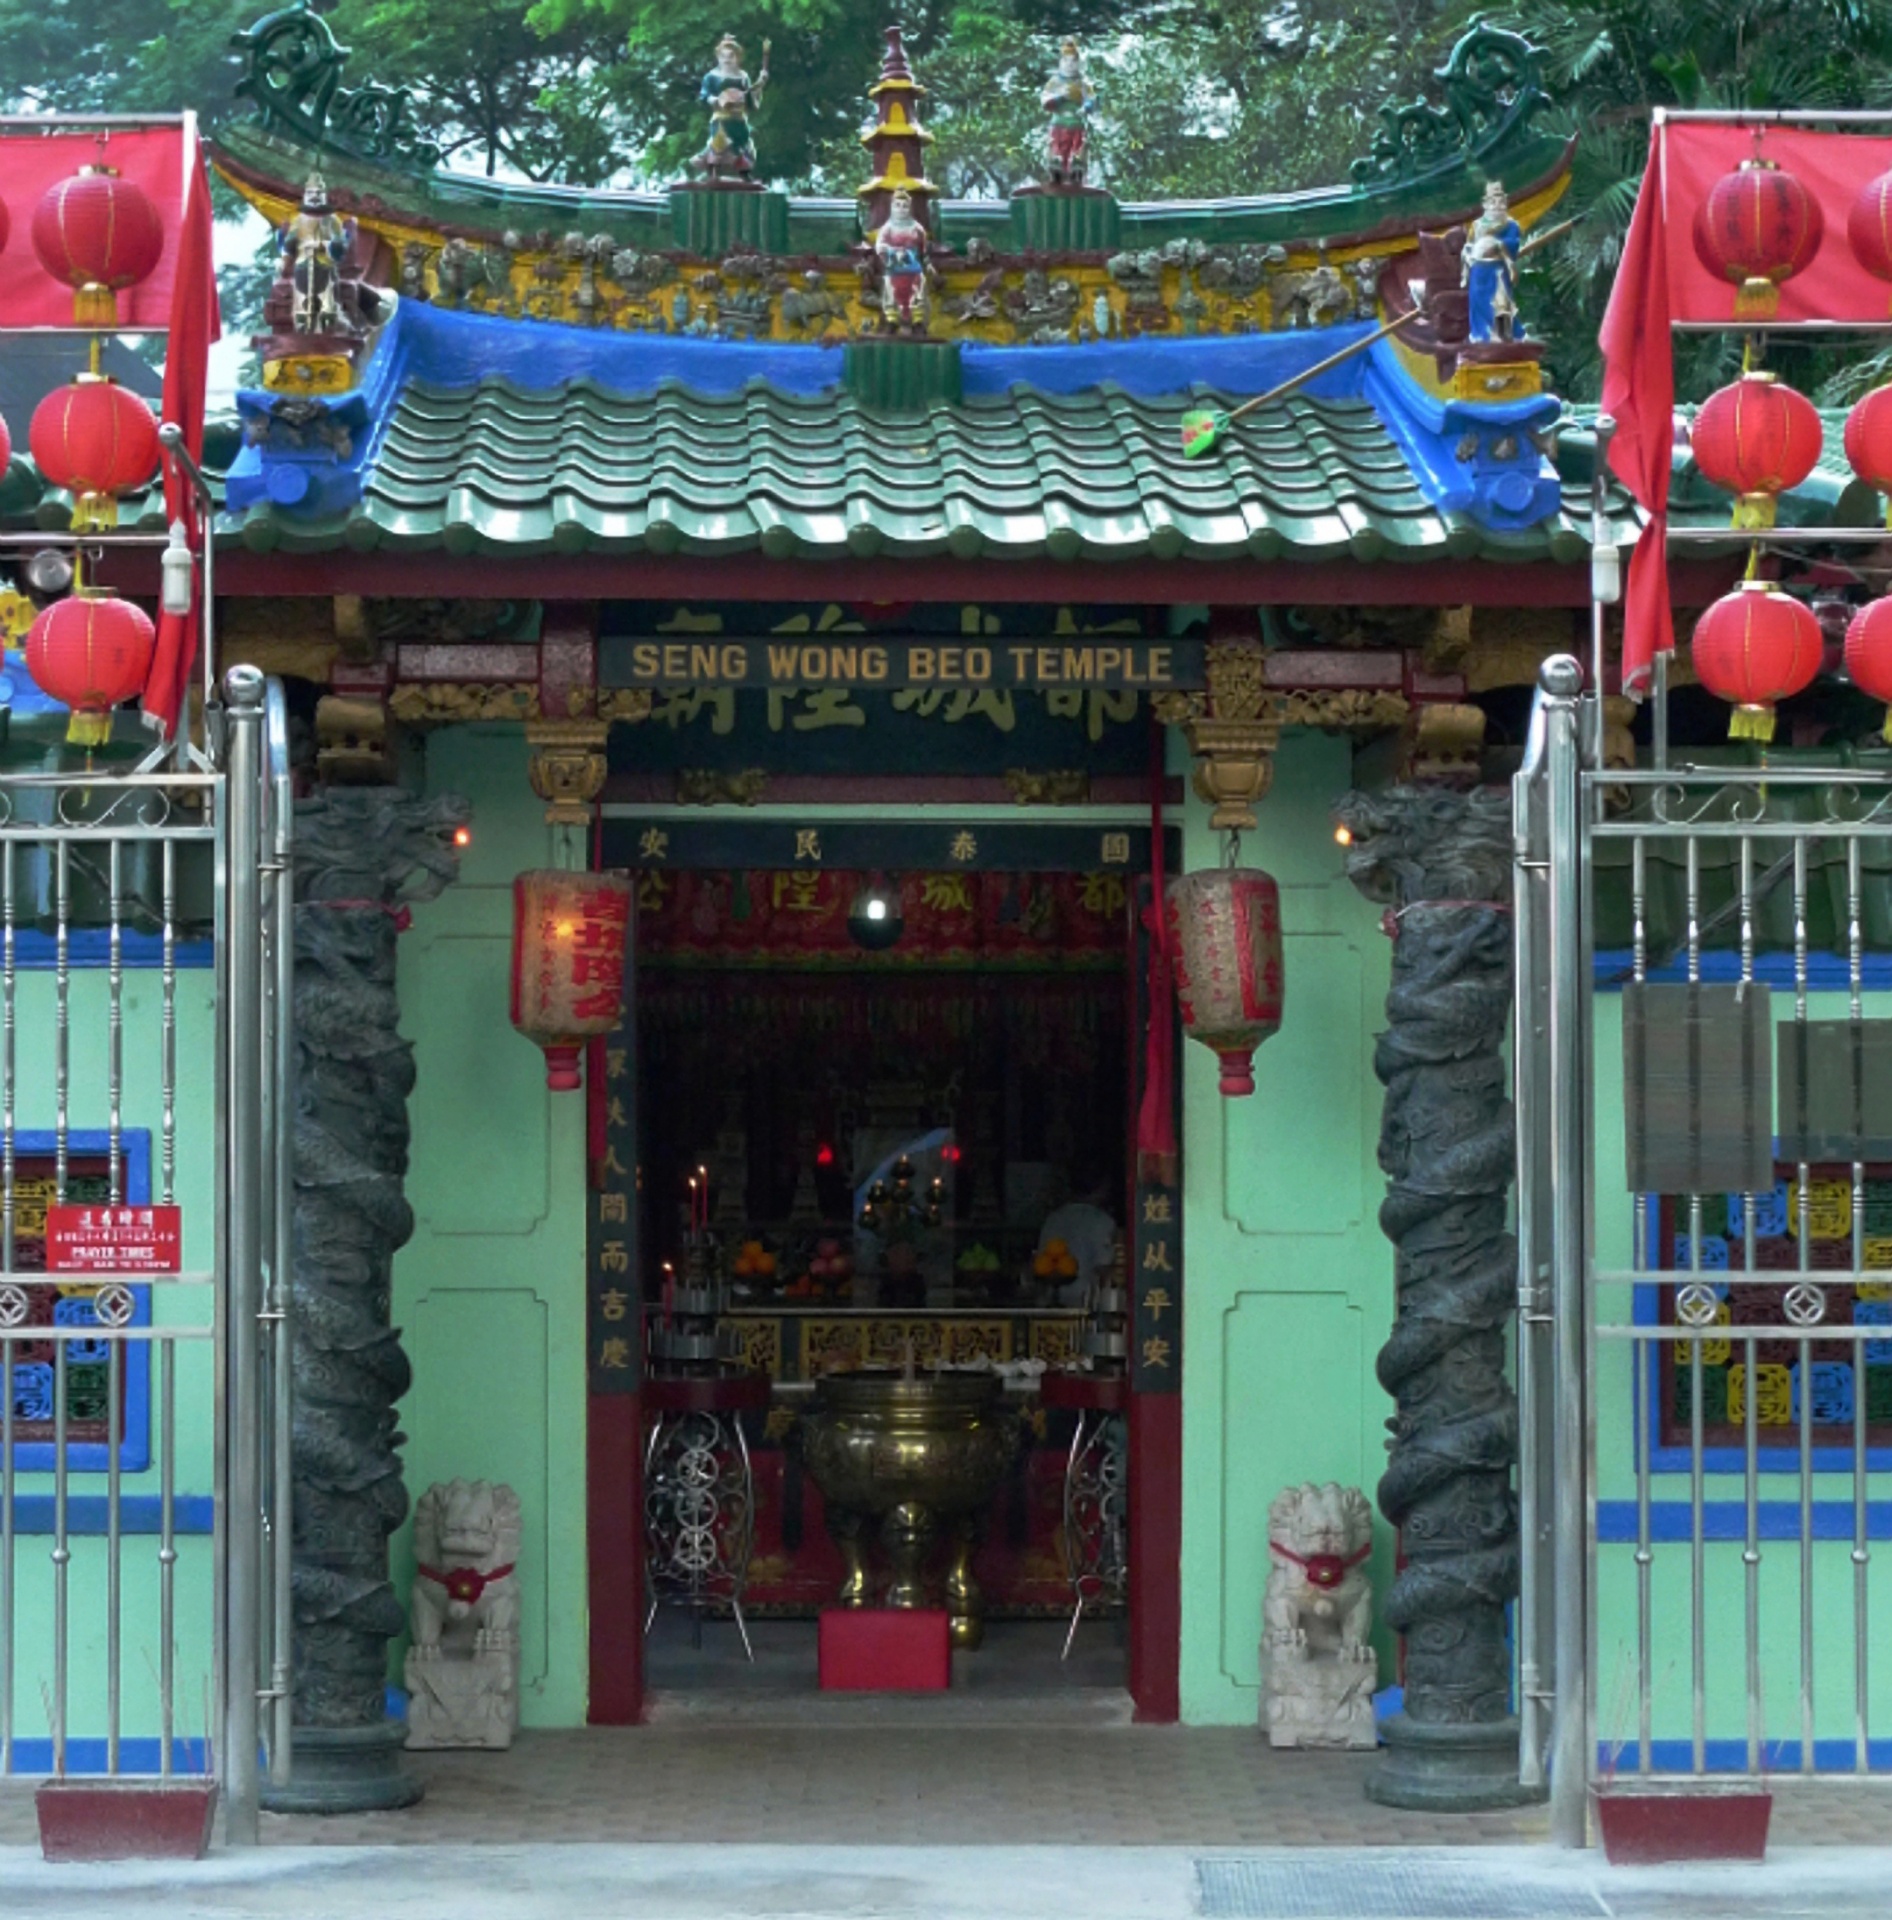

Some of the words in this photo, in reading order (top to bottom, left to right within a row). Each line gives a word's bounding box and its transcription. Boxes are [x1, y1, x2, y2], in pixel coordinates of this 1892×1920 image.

[631, 644, 748, 680] SENG
[768, 645, 888, 682] WONG
[908, 647, 992, 681] BEO
[1008, 647, 1173, 682] TEMPLE
